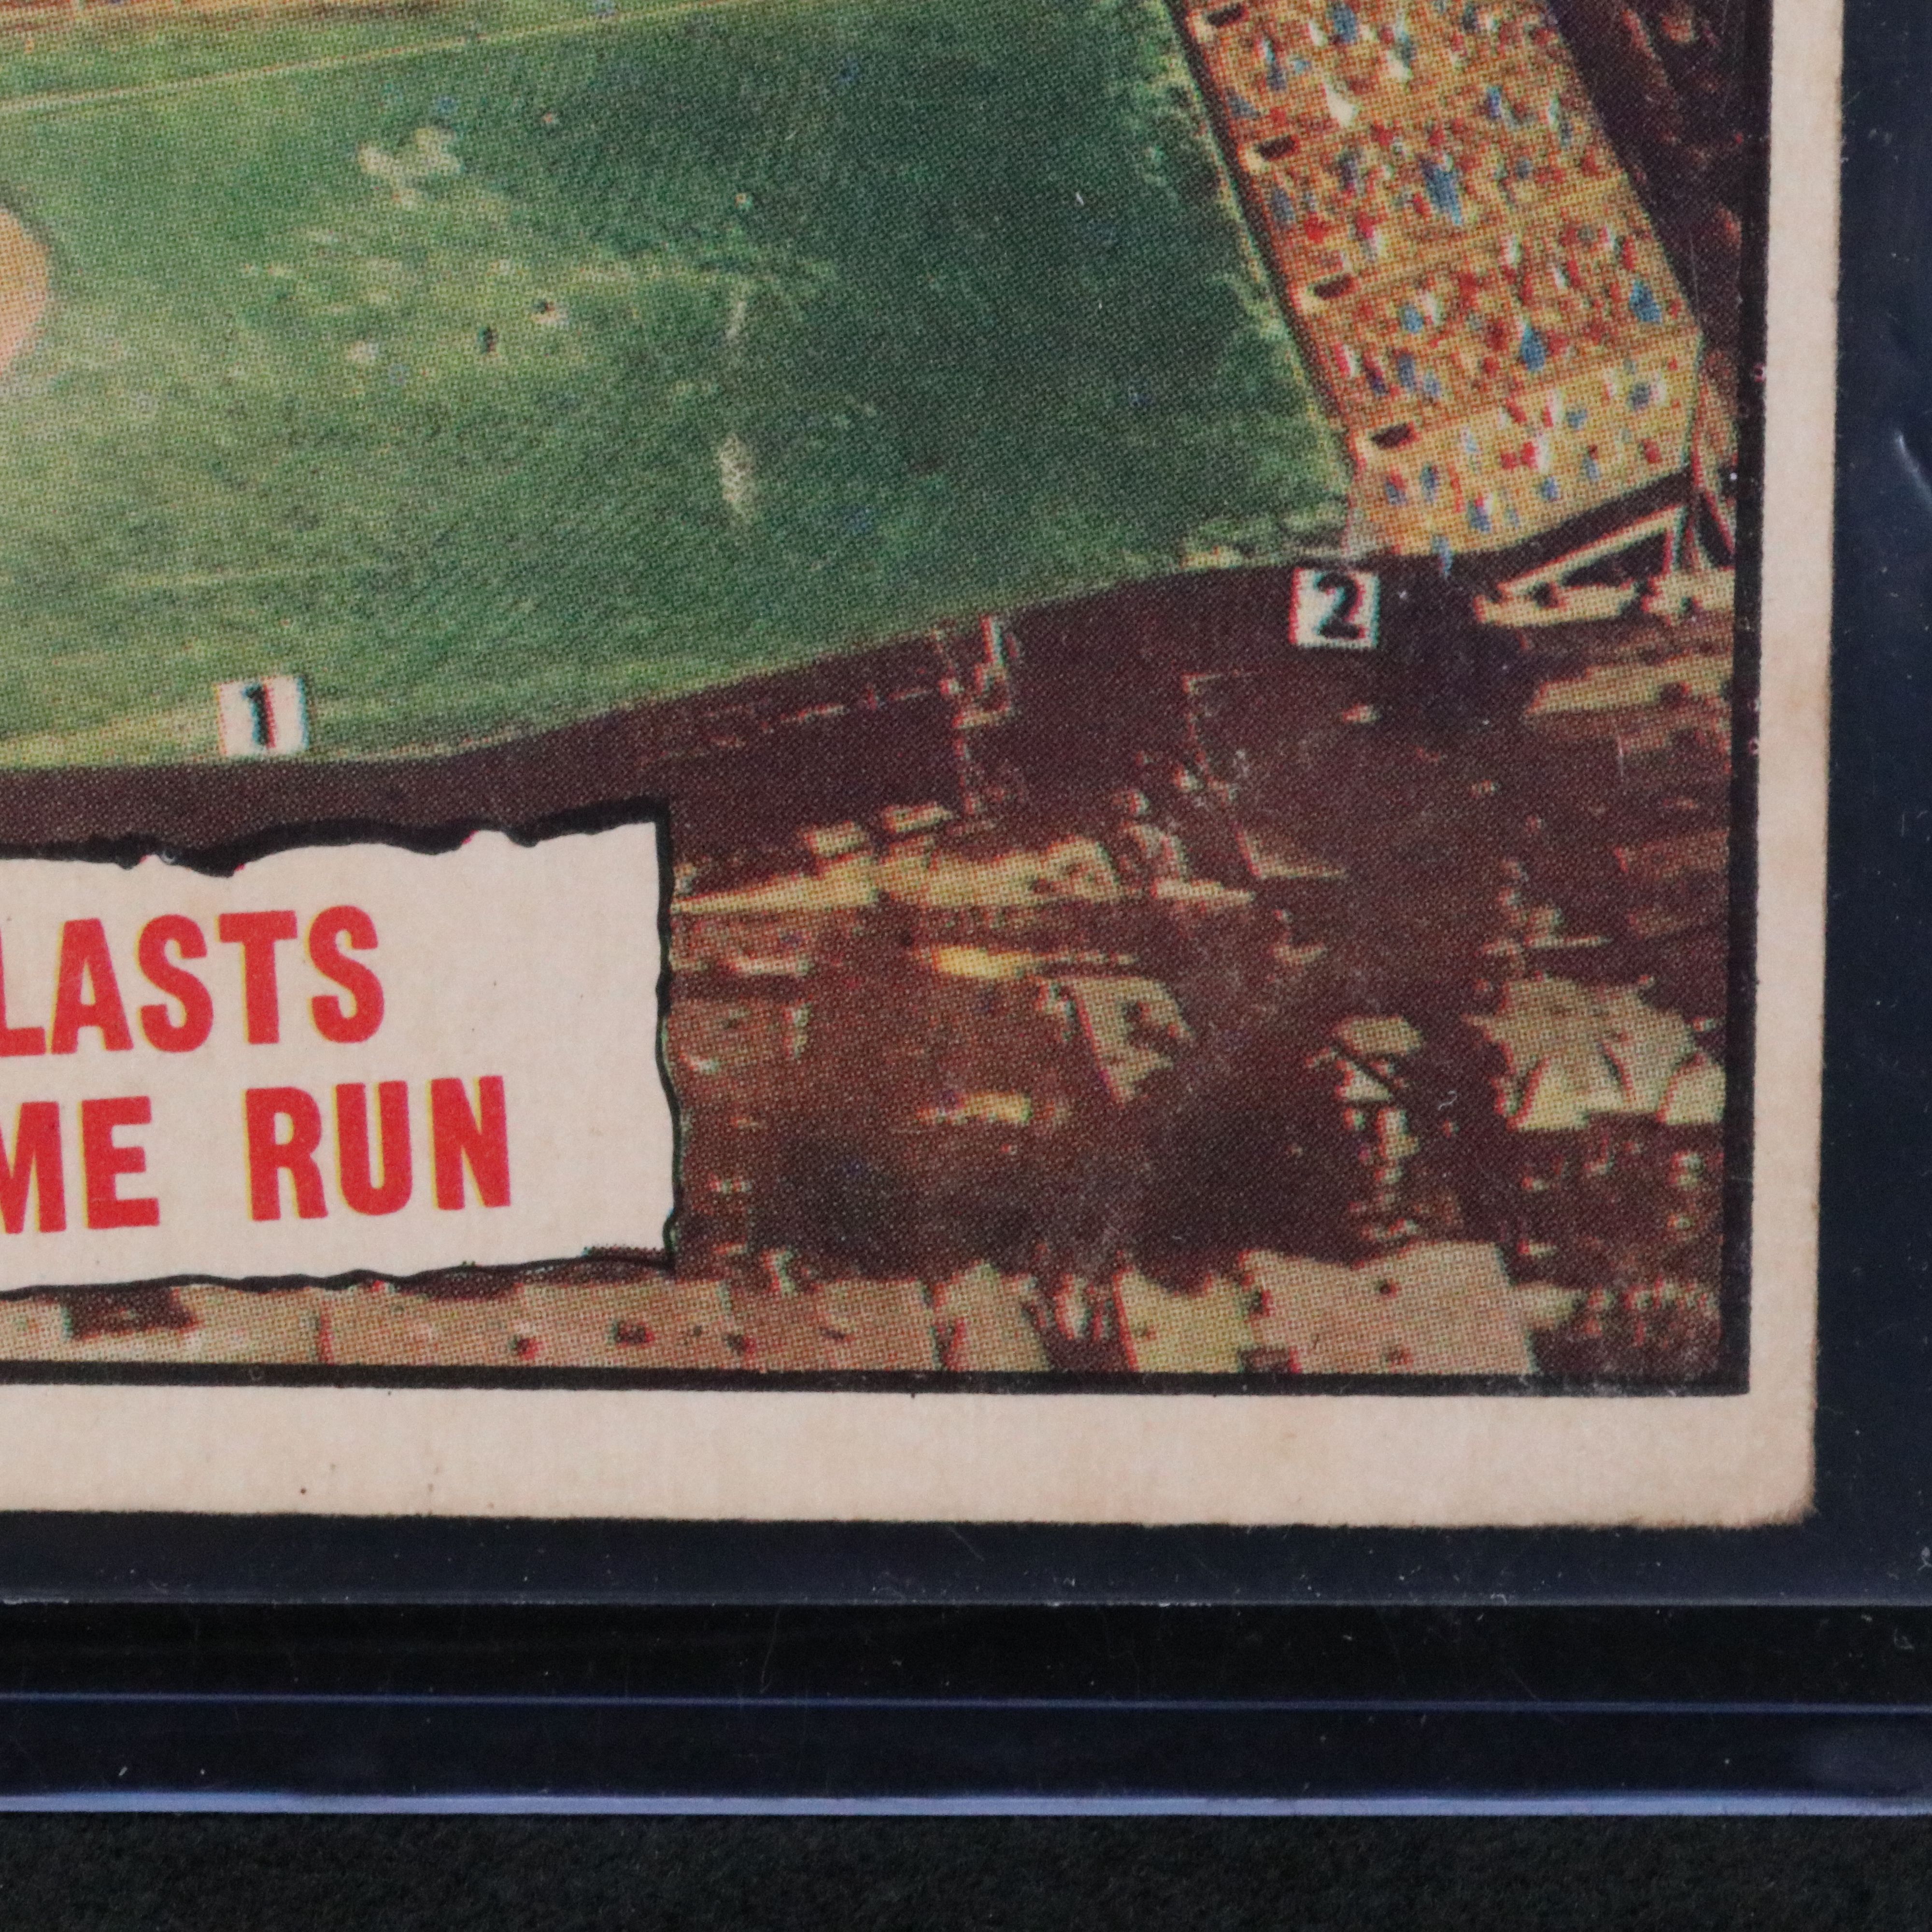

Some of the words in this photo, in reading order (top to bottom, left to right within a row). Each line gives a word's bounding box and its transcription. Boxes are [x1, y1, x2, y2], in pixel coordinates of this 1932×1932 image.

[1314, 572, 1365, 640] 2
[242, 682, 275, 747] 1
[242, 1075, 511, 1222] RUN
